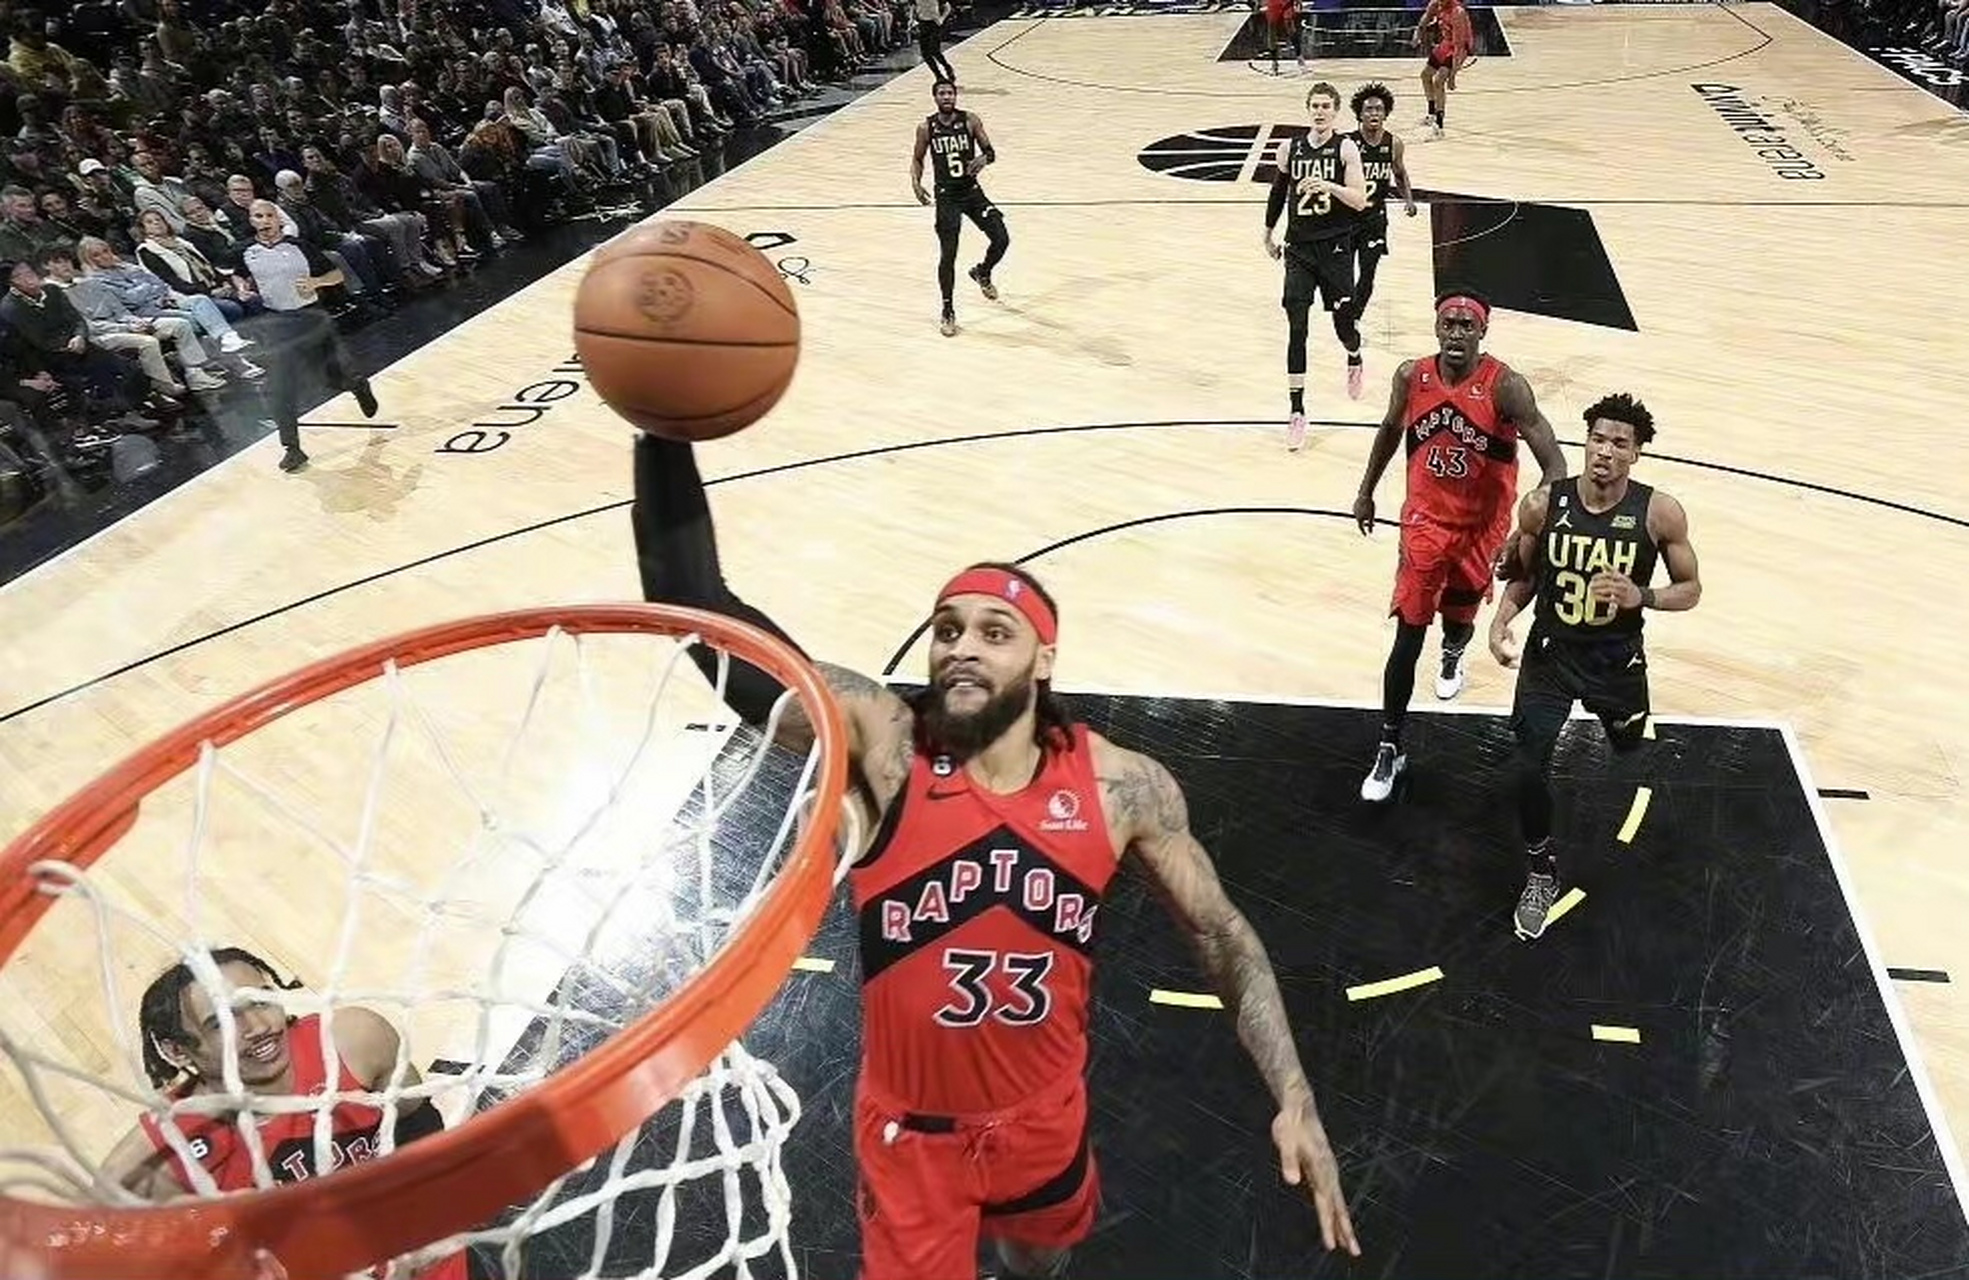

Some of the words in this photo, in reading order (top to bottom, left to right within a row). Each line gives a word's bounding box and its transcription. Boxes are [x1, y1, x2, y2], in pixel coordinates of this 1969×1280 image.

[931, 134, 969, 153] UTAH
[1743, 134, 1826, 179] arena
[946, 152, 964, 178] 5
[1291, 159, 1335, 180] UTAH
[1363, 162, 1391, 180] TAH
[1297, 190, 1331, 216] 23
[1426, 446, 1468, 477] 43
[1548, 532, 1638, 576] UTAH
[932, 948, 1054, 1028] 33
